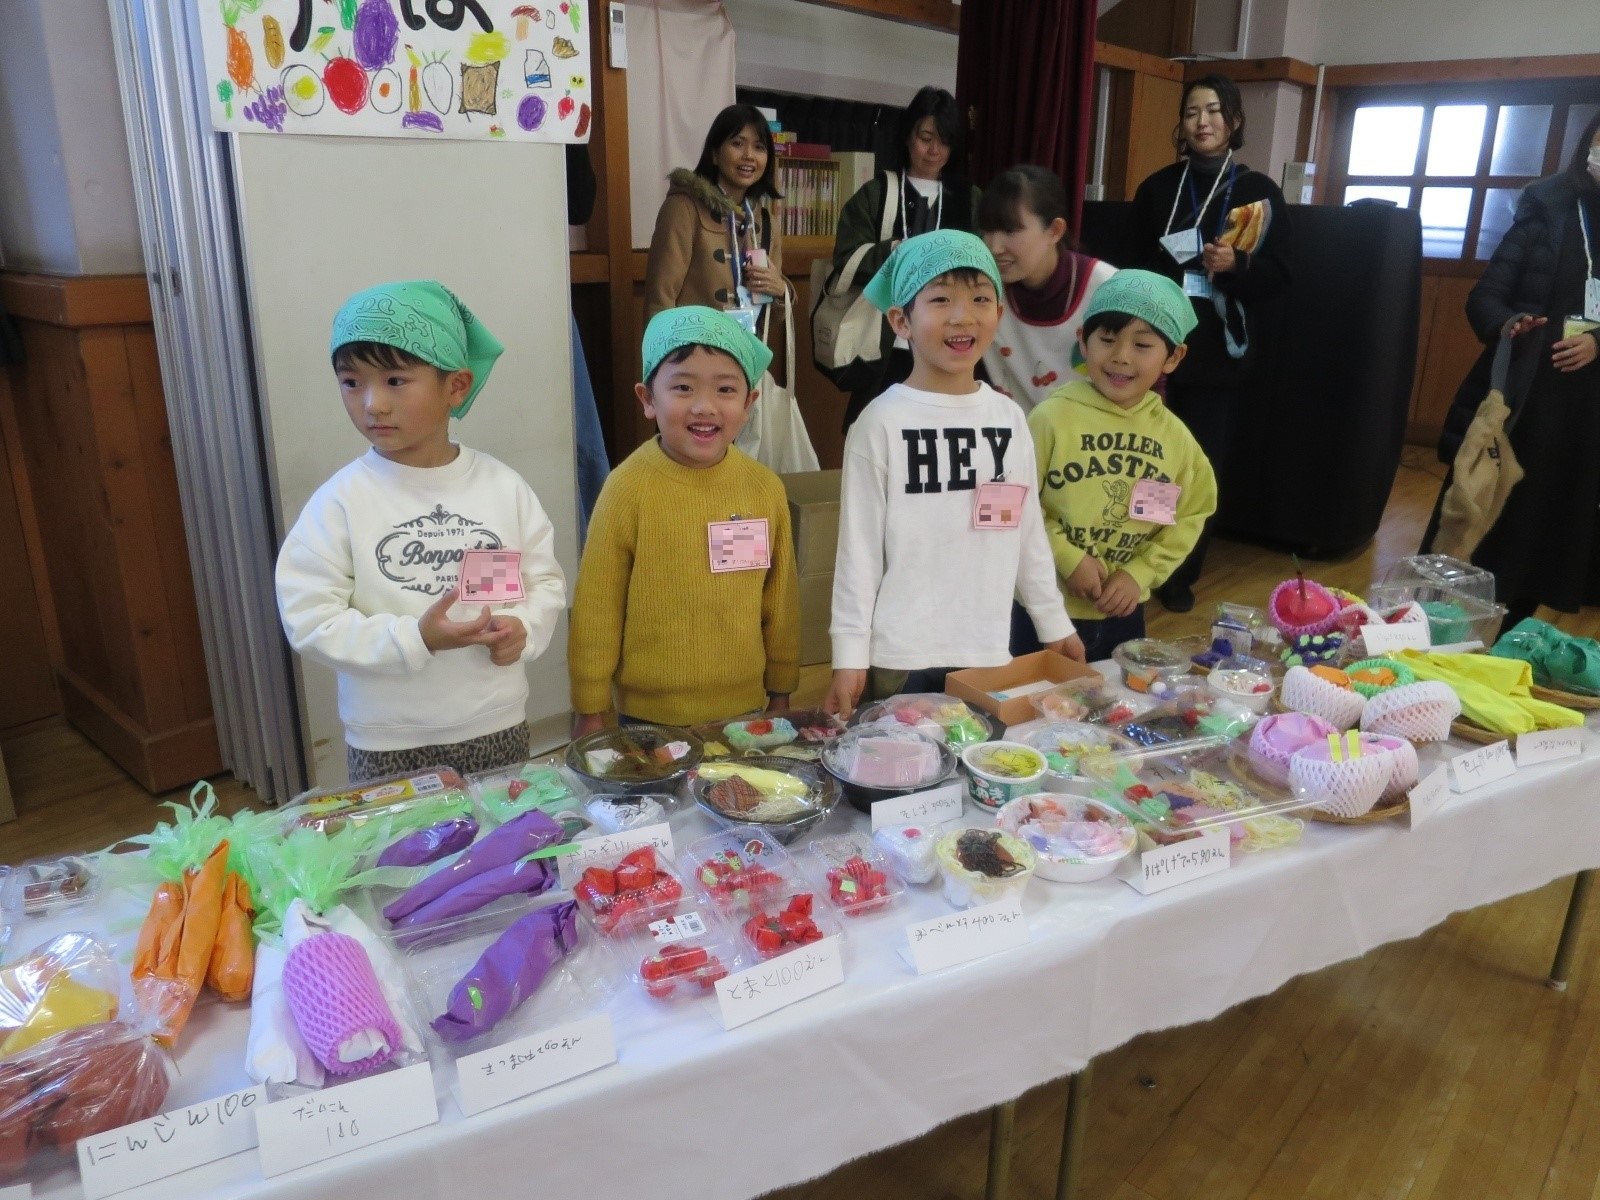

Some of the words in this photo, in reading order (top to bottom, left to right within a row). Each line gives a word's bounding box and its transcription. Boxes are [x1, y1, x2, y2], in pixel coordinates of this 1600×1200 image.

[1080, 432, 1164, 460] ROLLER
[901, 427, 1012, 494] HEY
[1047, 453, 1171, 490] COASTE
[417, 529, 445, 539] Depuis
[435, 574, 459, 583] PARIS
